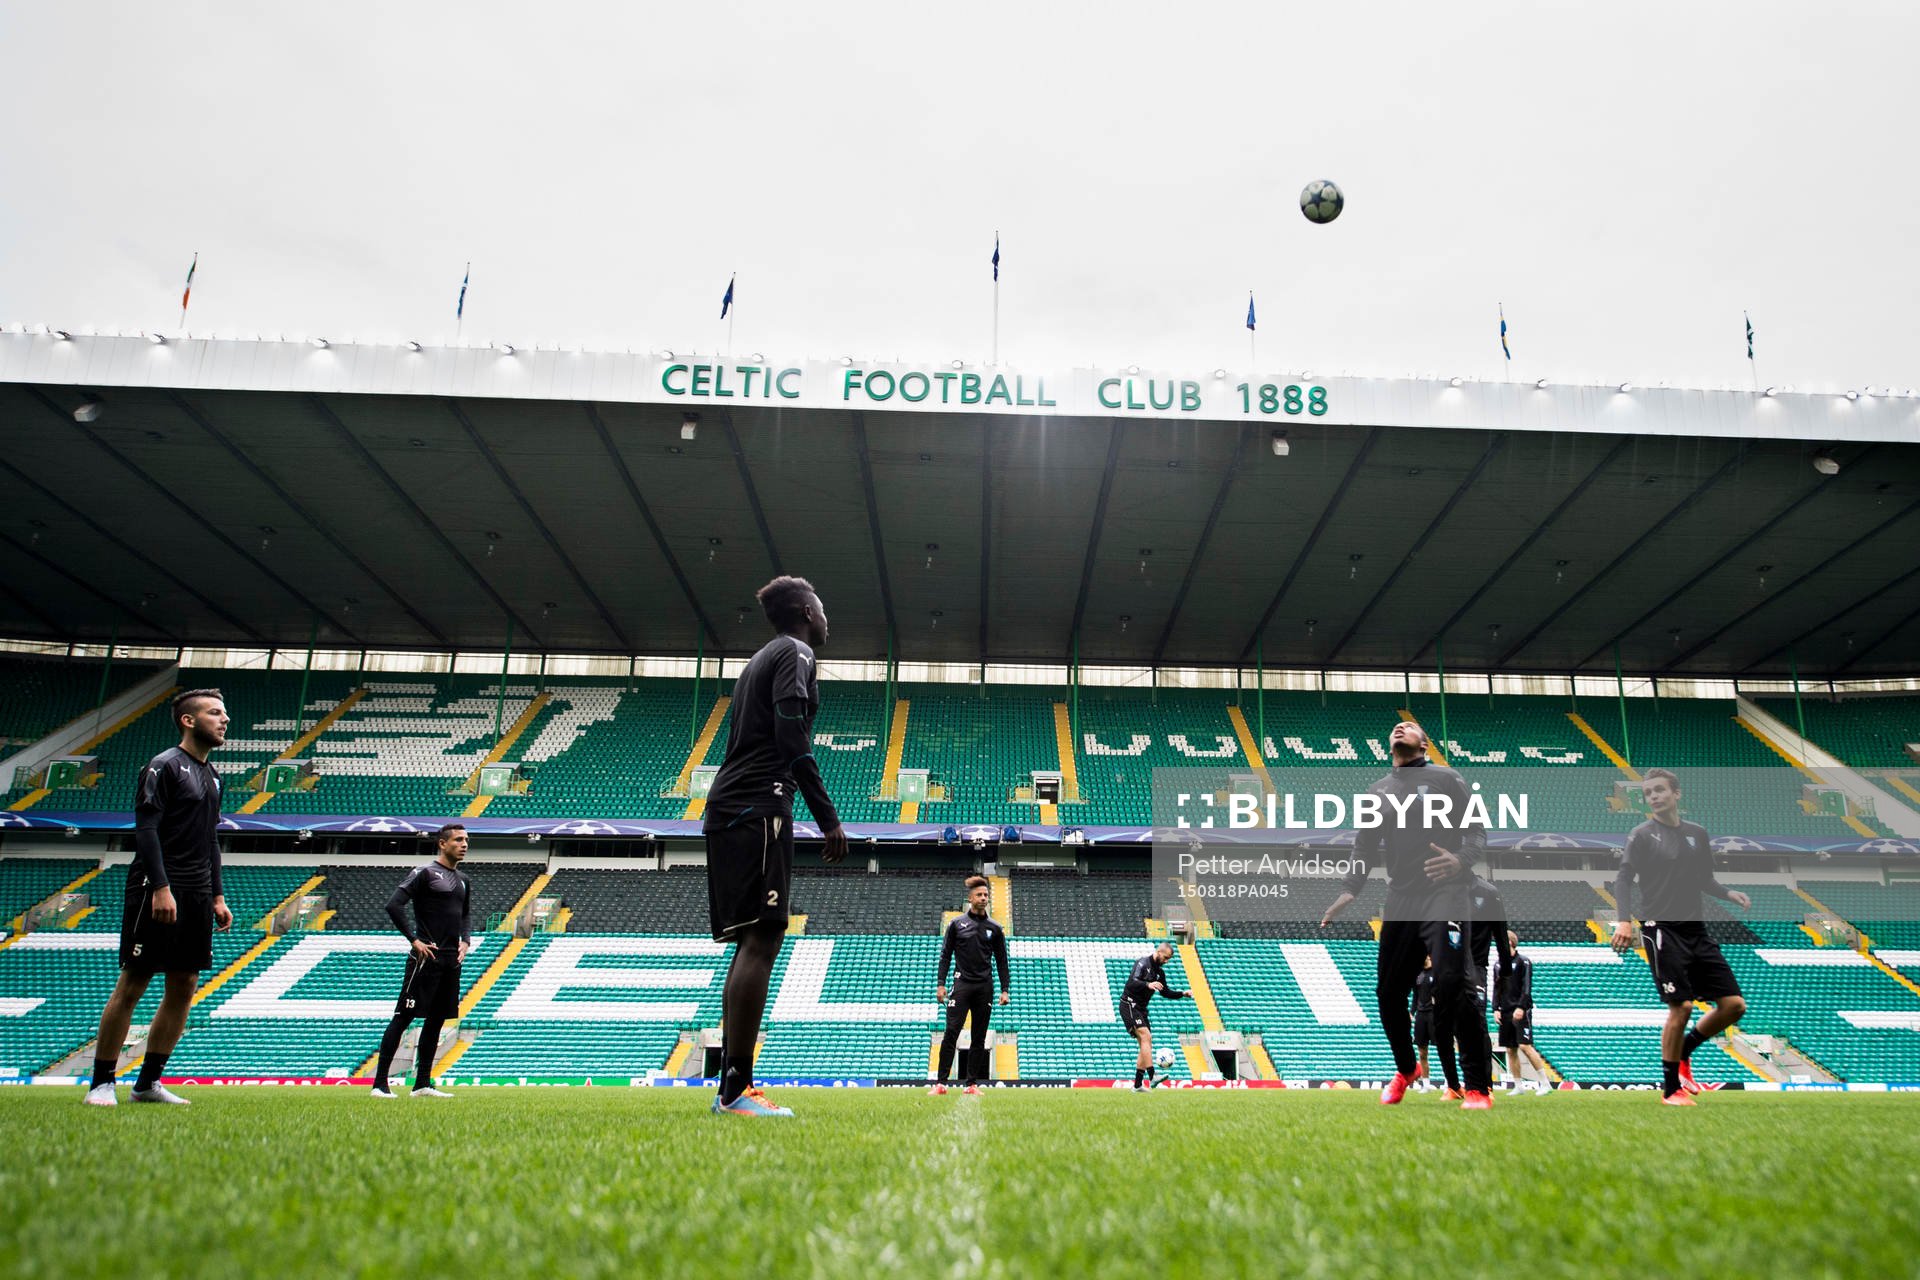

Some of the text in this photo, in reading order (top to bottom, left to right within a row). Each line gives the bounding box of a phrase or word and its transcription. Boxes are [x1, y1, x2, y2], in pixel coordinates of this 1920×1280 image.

[661, 364, 1329, 416] CELTIC FOOTBALL CLUB 1888
[767, 889, 778, 906] 2
[133, 943, 143, 956] 5
[405, 998, 416, 1008] 13
